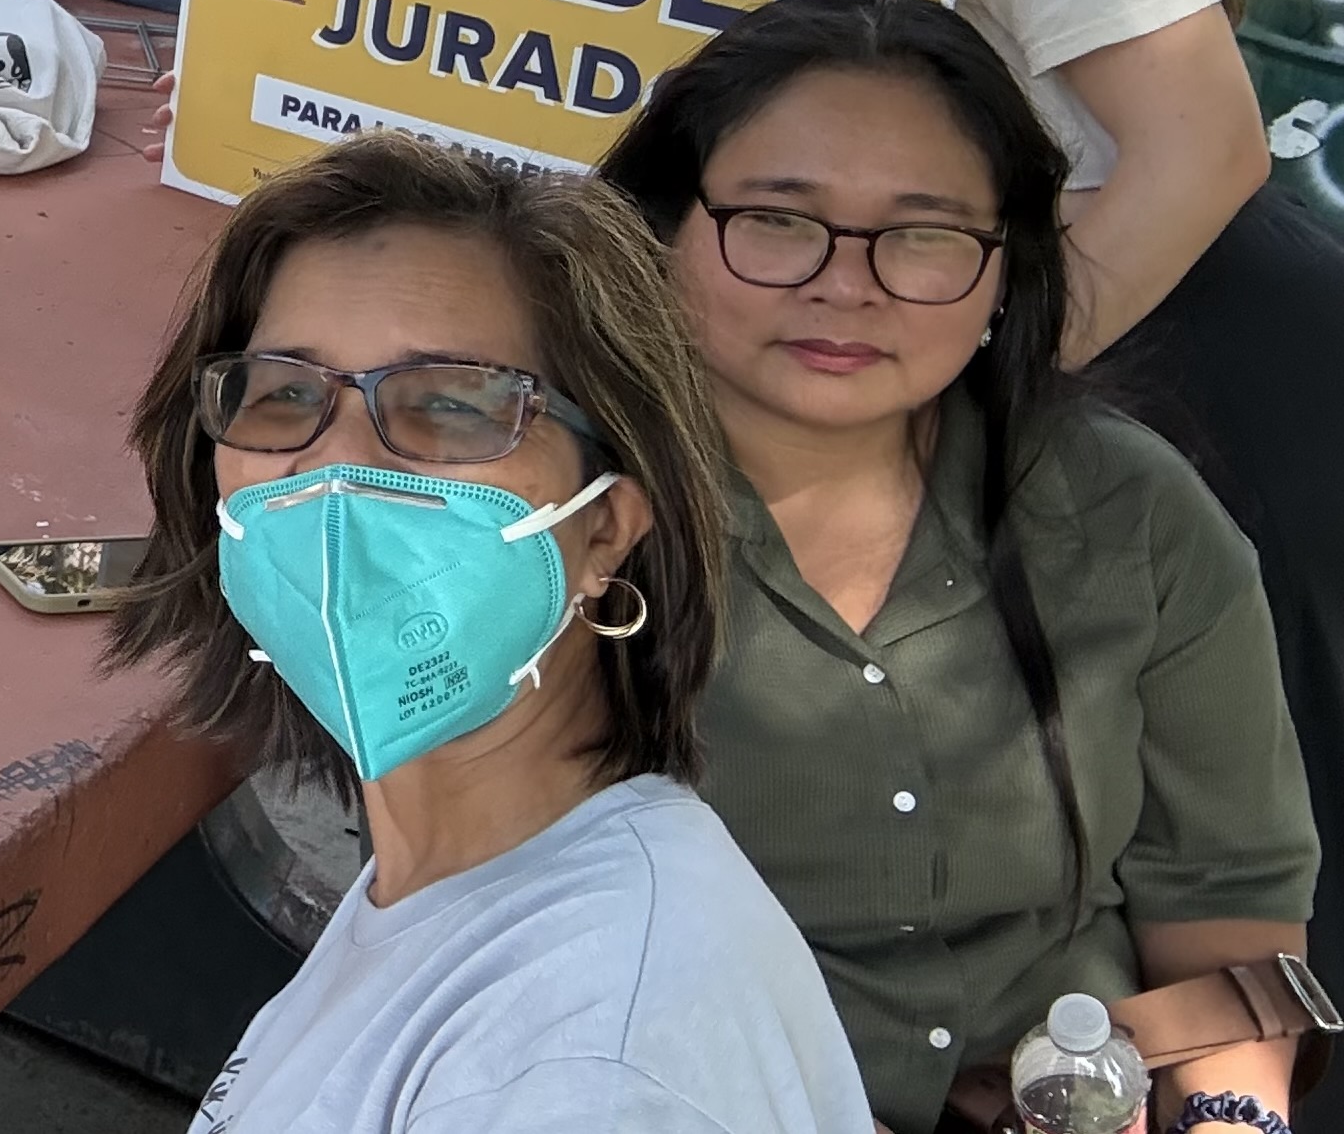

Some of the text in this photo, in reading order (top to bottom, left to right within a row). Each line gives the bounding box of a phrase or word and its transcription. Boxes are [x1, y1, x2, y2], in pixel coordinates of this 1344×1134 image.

[279, 93, 362, 134] PARA
[398, 685, 434, 708] NIOSH
[398, 707, 416, 722] LOT
